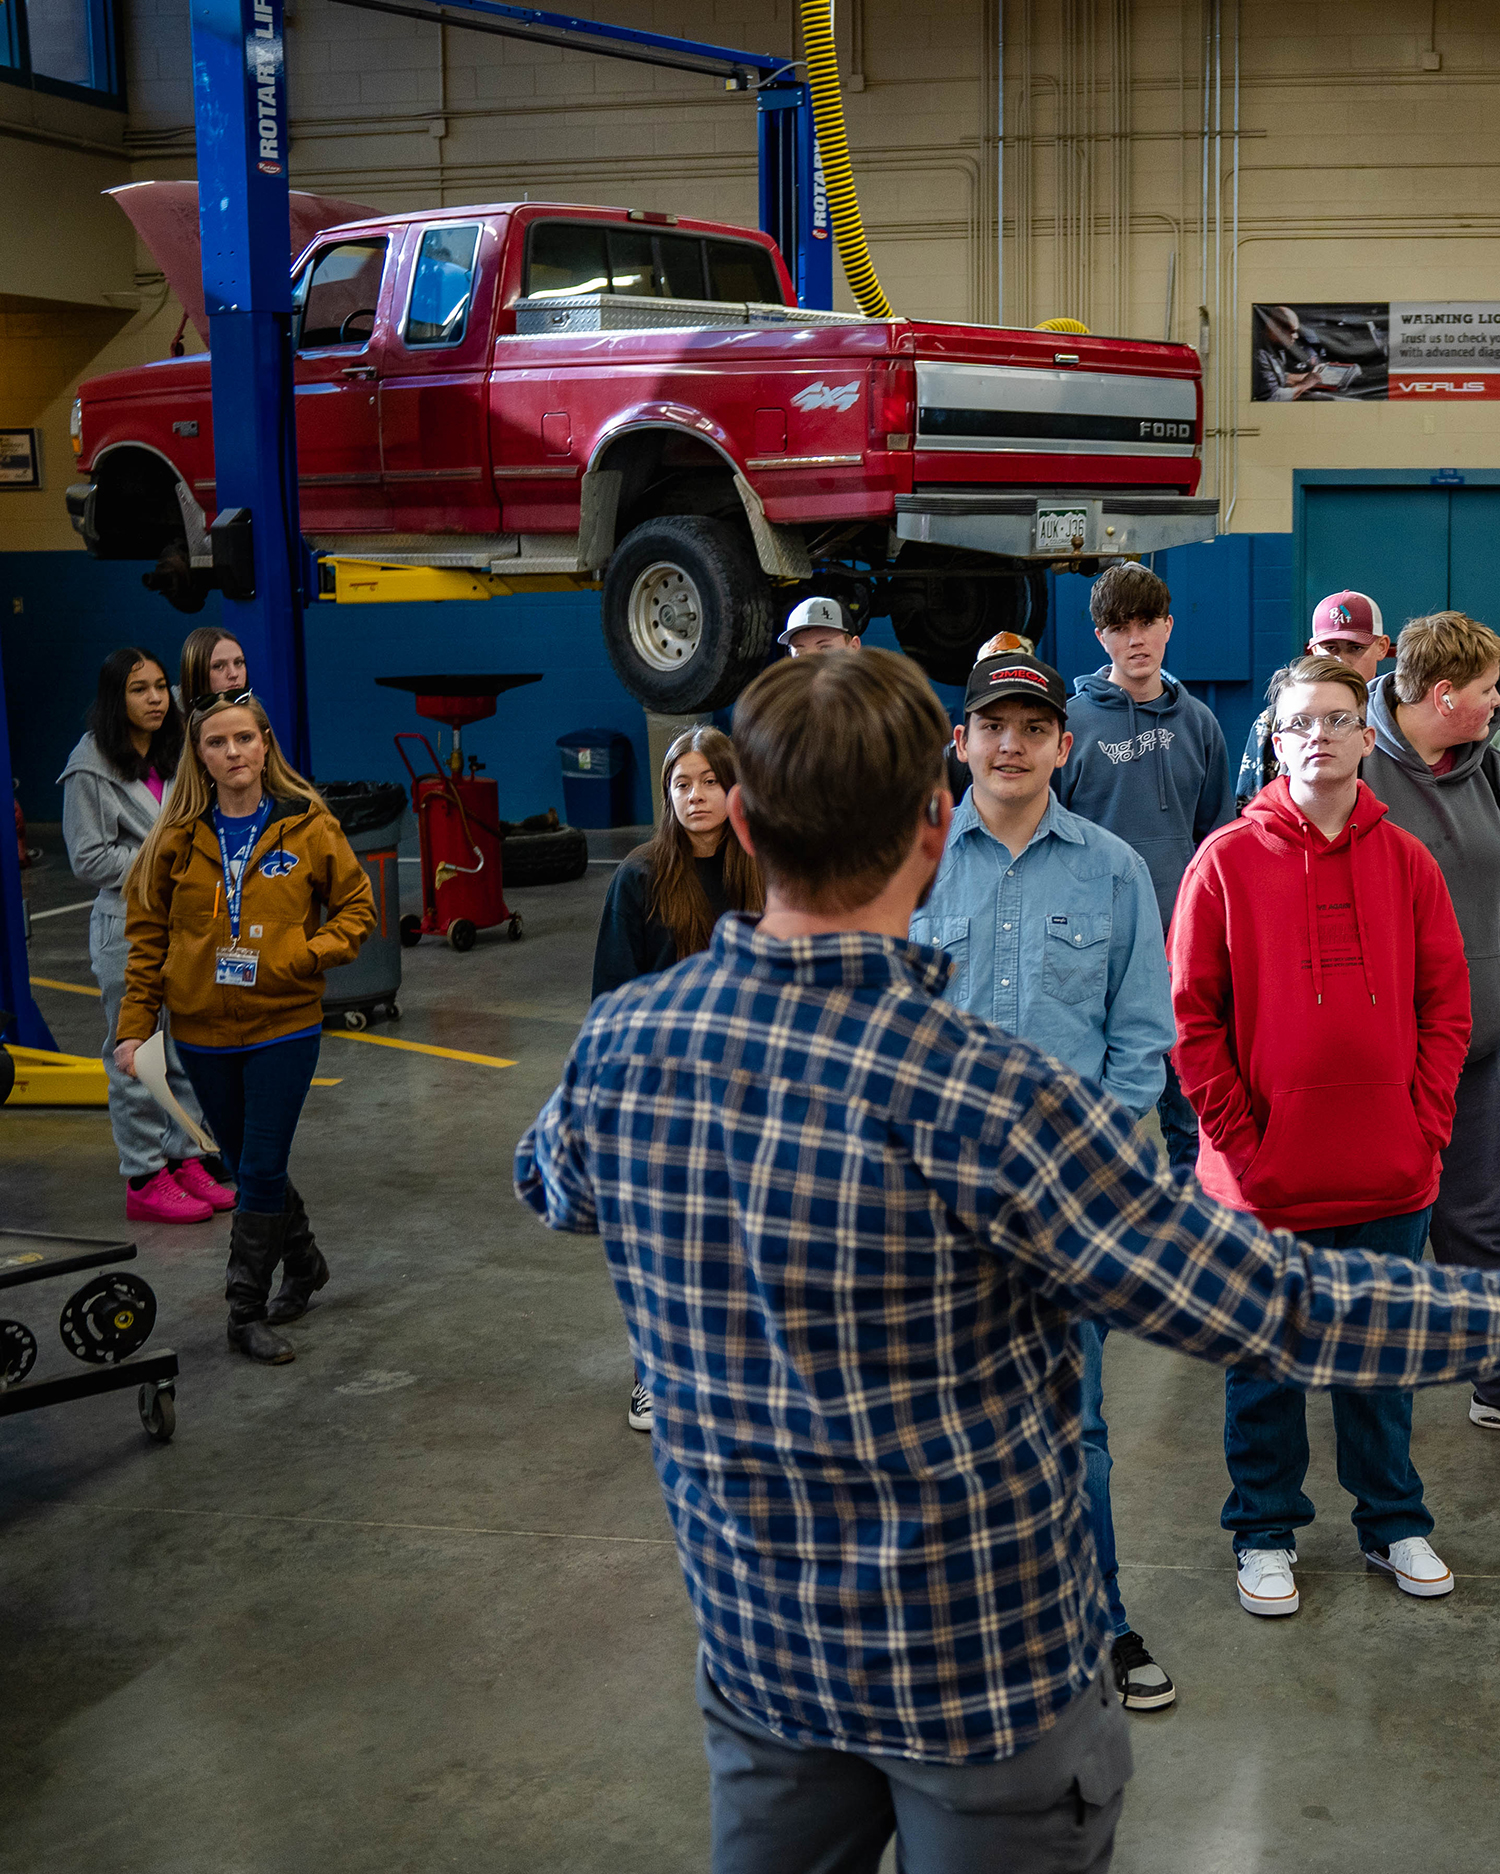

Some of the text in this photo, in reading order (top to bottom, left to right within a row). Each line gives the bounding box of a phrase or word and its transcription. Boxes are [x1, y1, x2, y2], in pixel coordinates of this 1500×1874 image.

[254, 0, 279, 159] ROTARY LIF
[1401, 314, 1473, 324] WARNING
[1401, 333, 1426, 343] Trust
[1429, 335, 1442, 343] us
[1444, 334, 1454, 343] to
[1458, 333, 1487, 343] check
[1400, 347, 1423, 357] with
[1426, 347, 1475, 357] advanced
[1398, 382, 1485, 392] VERUS
[1140, 421, 1190, 438] FORD
[992, 669, 1047, 687] OMEGA
